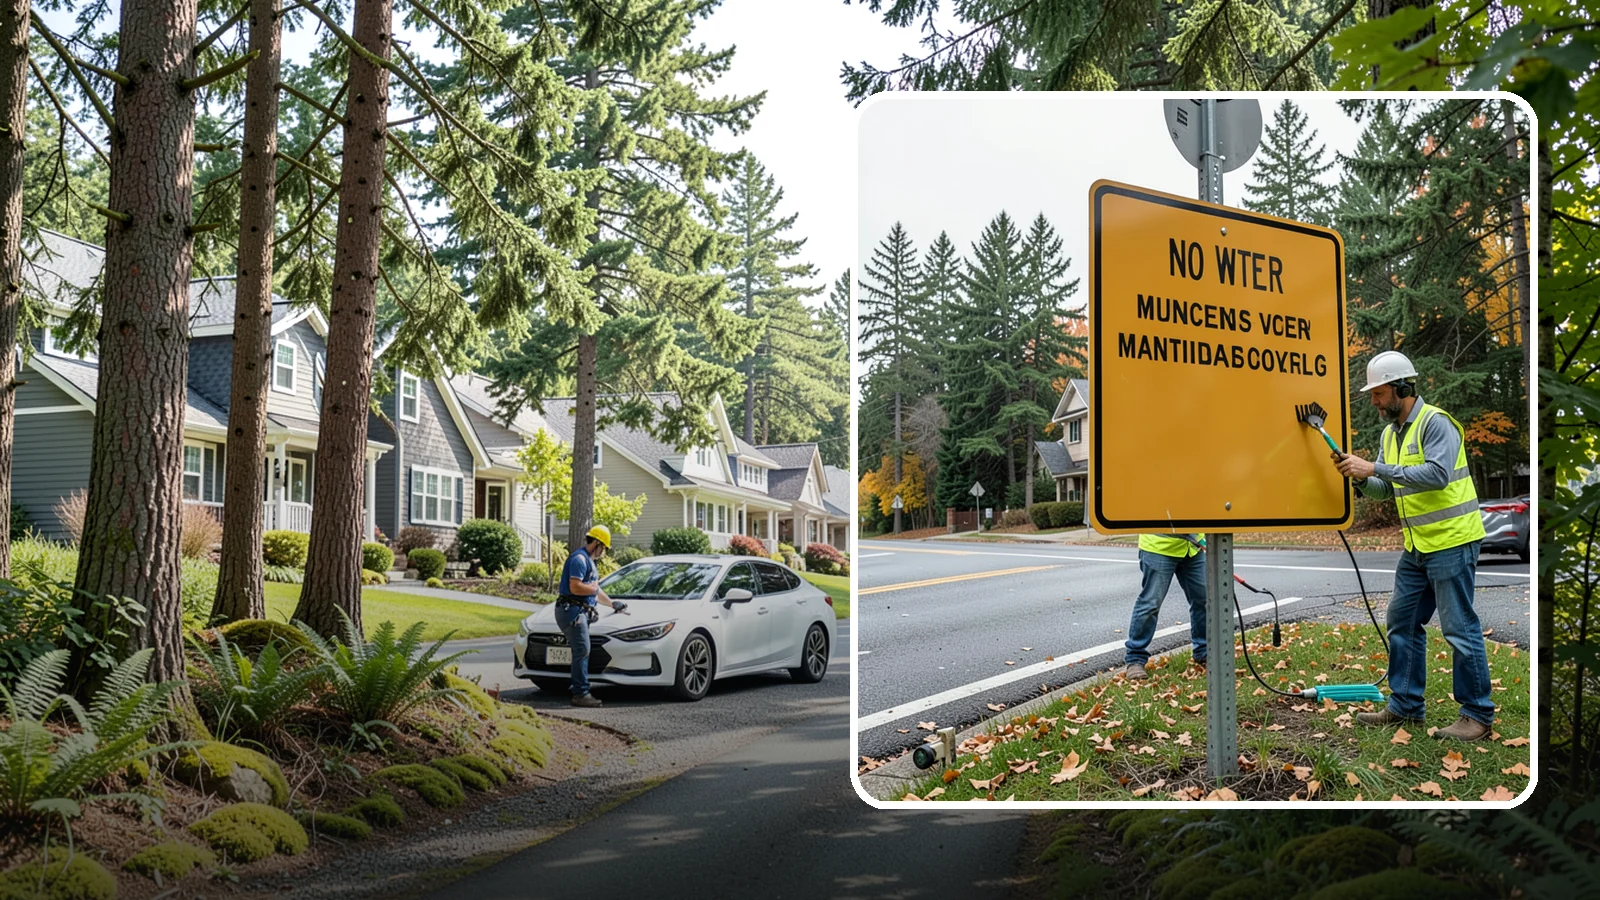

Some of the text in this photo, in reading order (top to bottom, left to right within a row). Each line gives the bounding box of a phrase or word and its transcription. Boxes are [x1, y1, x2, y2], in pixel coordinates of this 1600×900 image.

[1169, 238, 1284, 294] NO WTER
[1137, 294, 1252, 333] MUNCENS
